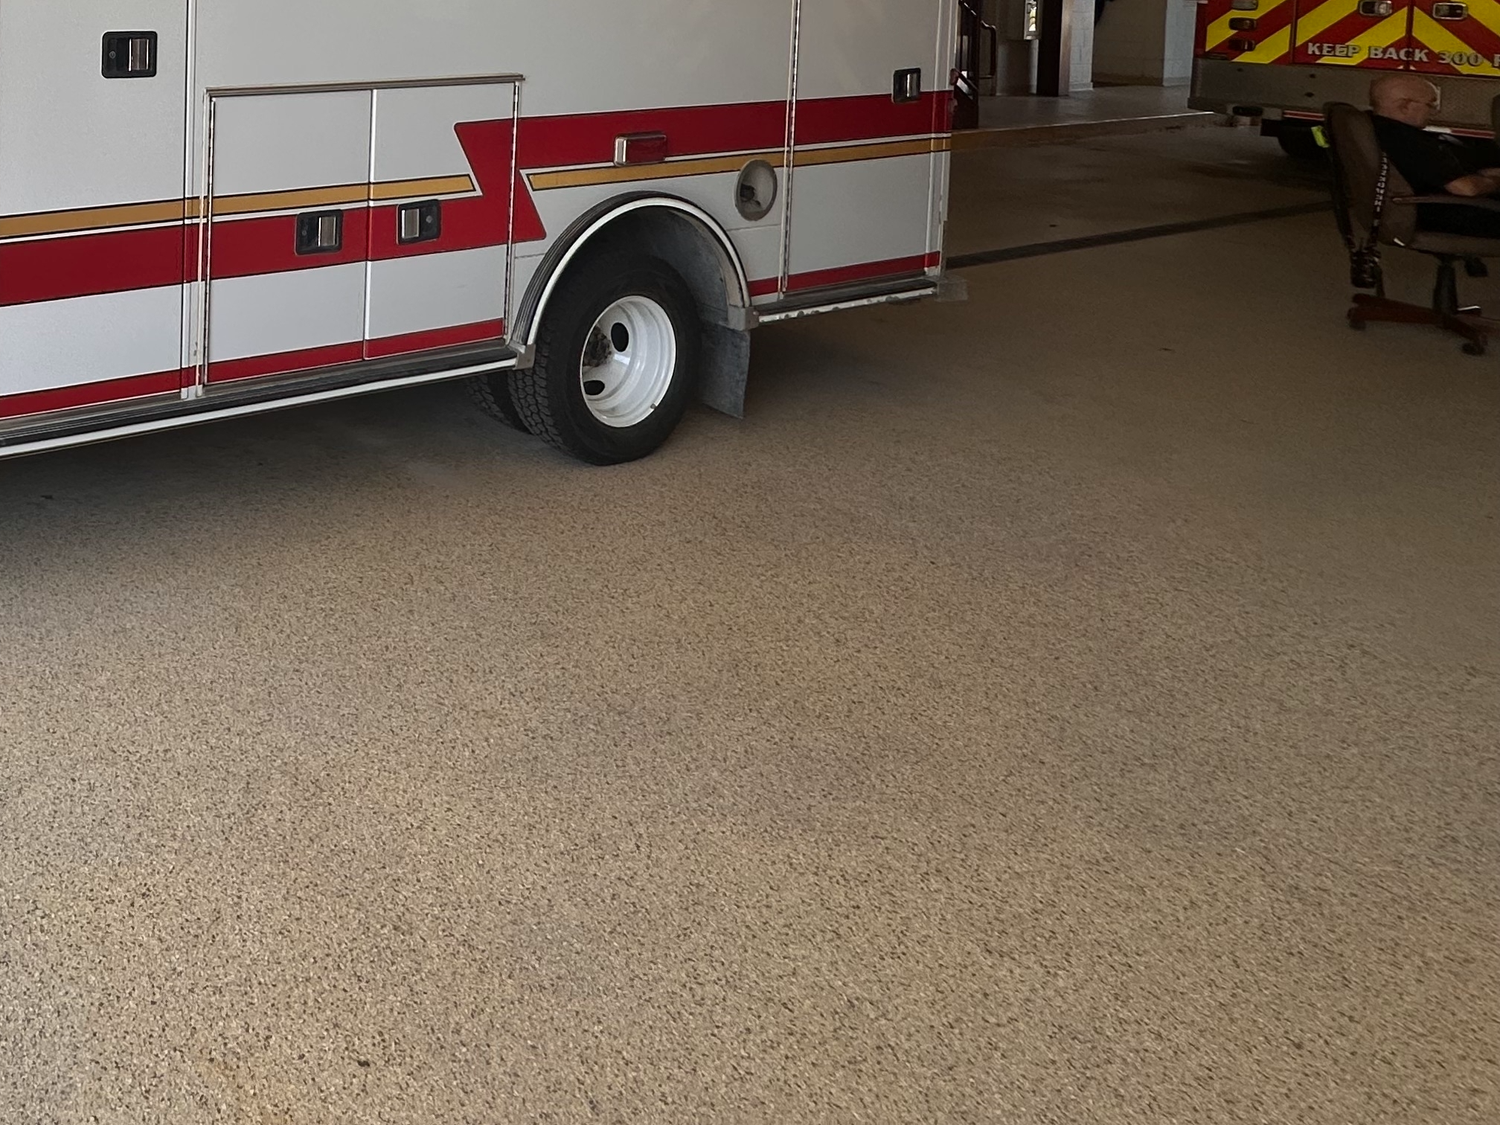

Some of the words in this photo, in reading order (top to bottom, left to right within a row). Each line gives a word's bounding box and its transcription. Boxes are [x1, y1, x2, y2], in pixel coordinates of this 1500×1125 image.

[1307, 41, 1362, 58] KEEP
[1368, 45, 1430, 63] BACK
[1437, 50, 1484, 68] 300
